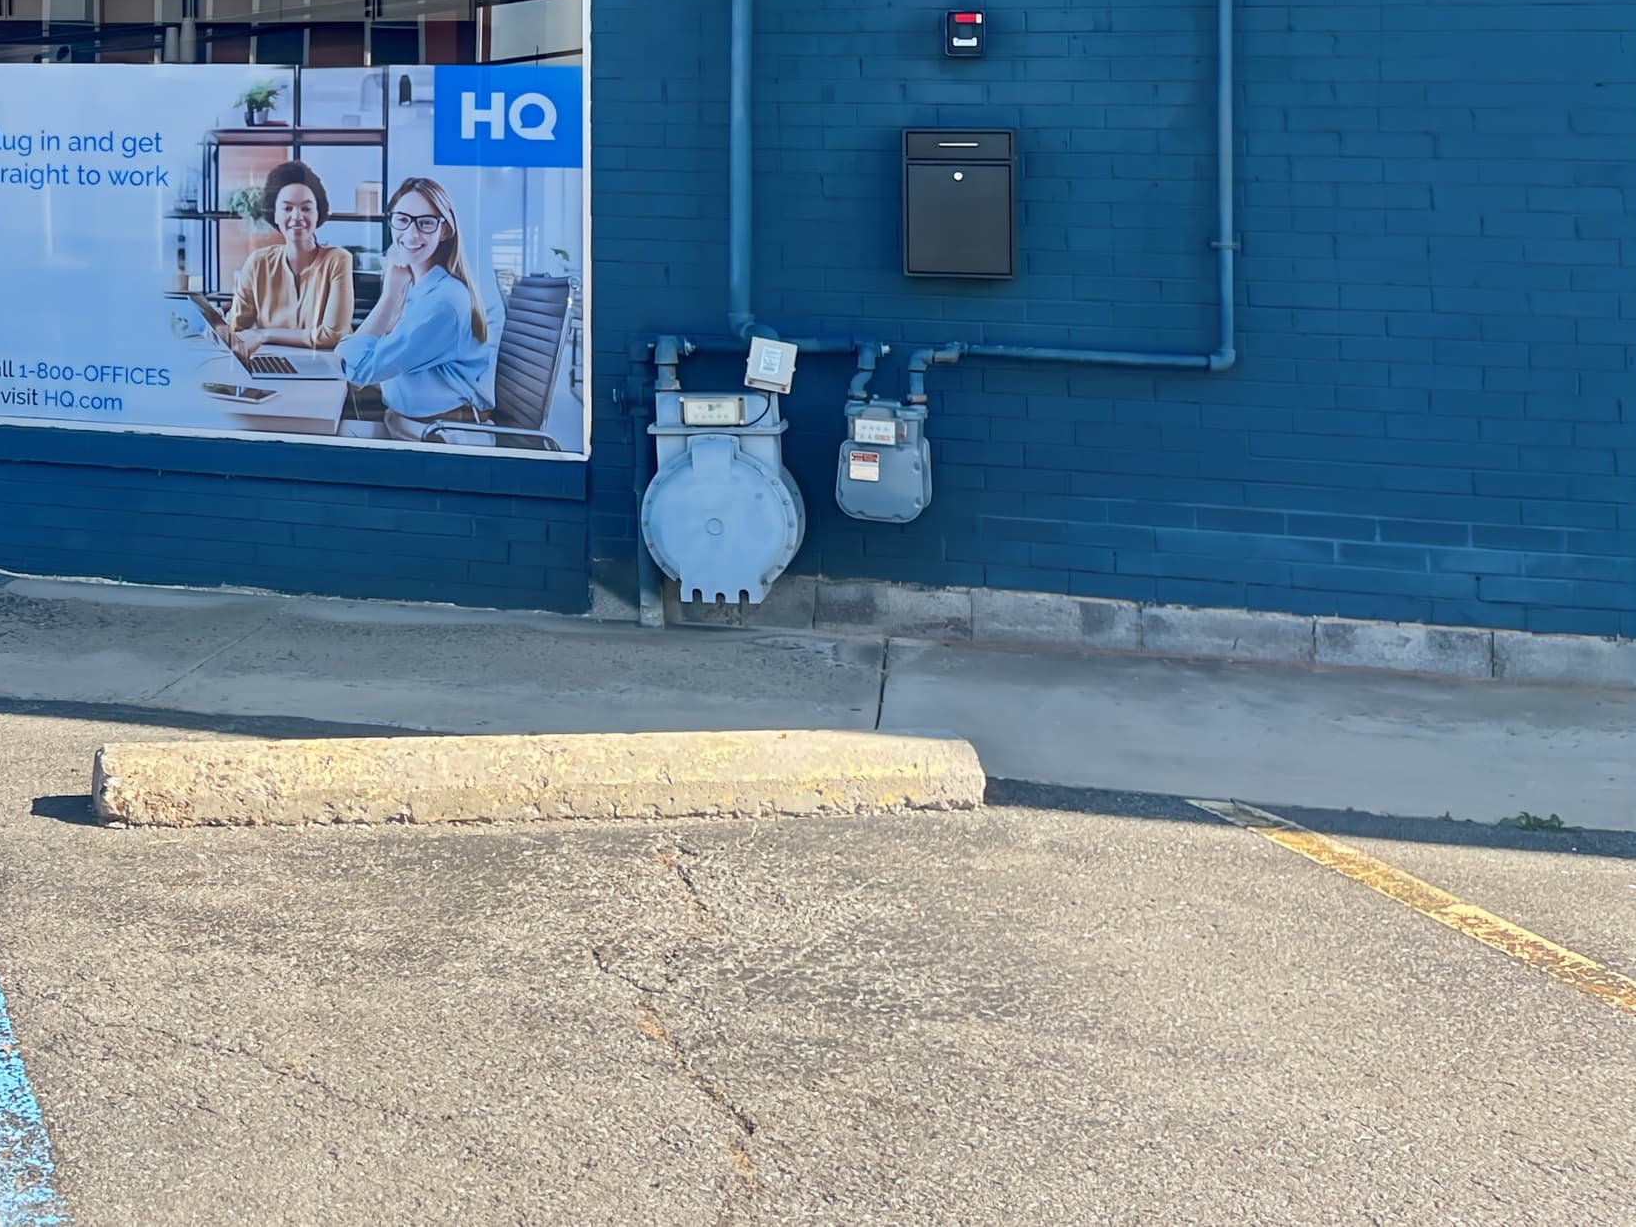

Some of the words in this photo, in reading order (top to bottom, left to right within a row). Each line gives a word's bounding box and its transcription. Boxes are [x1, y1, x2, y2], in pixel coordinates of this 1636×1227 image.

[461, 92, 557, 141] HQ
[40, 129, 60, 151] in
[68, 131, 114, 152] and
[121, 132, 163, 158] get
[77, 164, 101, 185] to
[108, 165, 169, 187] work
[19, 362, 171, 387] 1-800-OFFICES
[1, 387, 39, 406] visit
[44, 389, 123, 411] HQ.com
